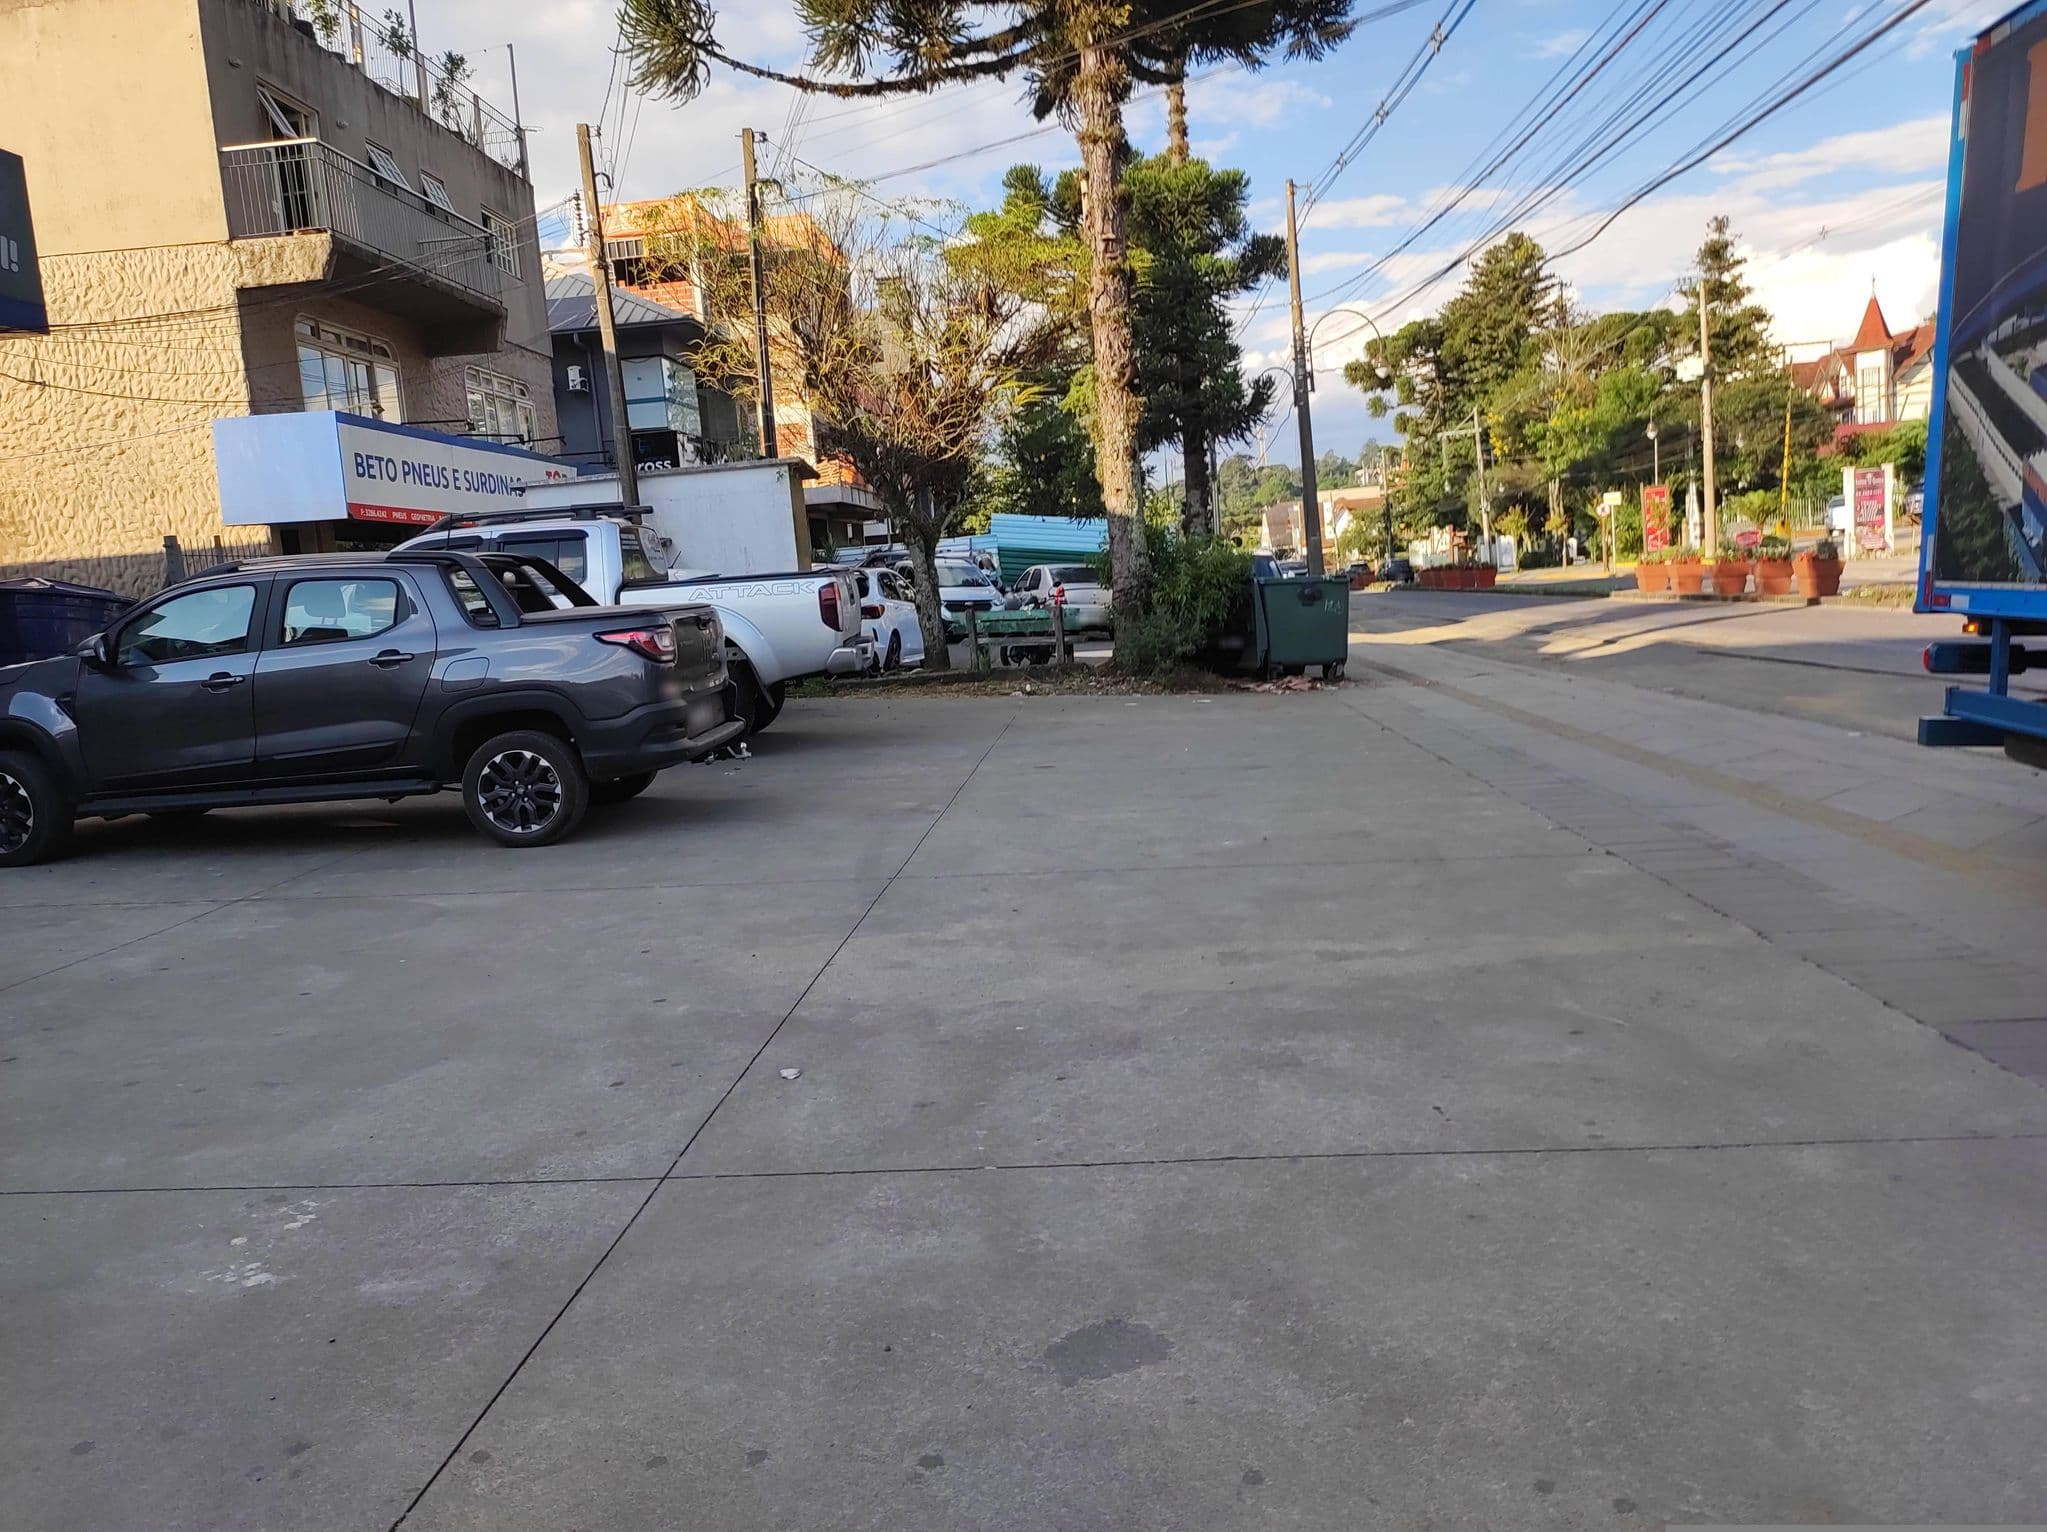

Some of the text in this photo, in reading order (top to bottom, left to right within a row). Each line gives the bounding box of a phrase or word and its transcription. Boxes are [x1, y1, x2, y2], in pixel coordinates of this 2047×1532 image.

[354, 452, 397, 482] BETO
[401, 460, 449, 489] PNEUS
[453, 468, 462, 490] E
[688, 581, 816, 601] ATTACK
